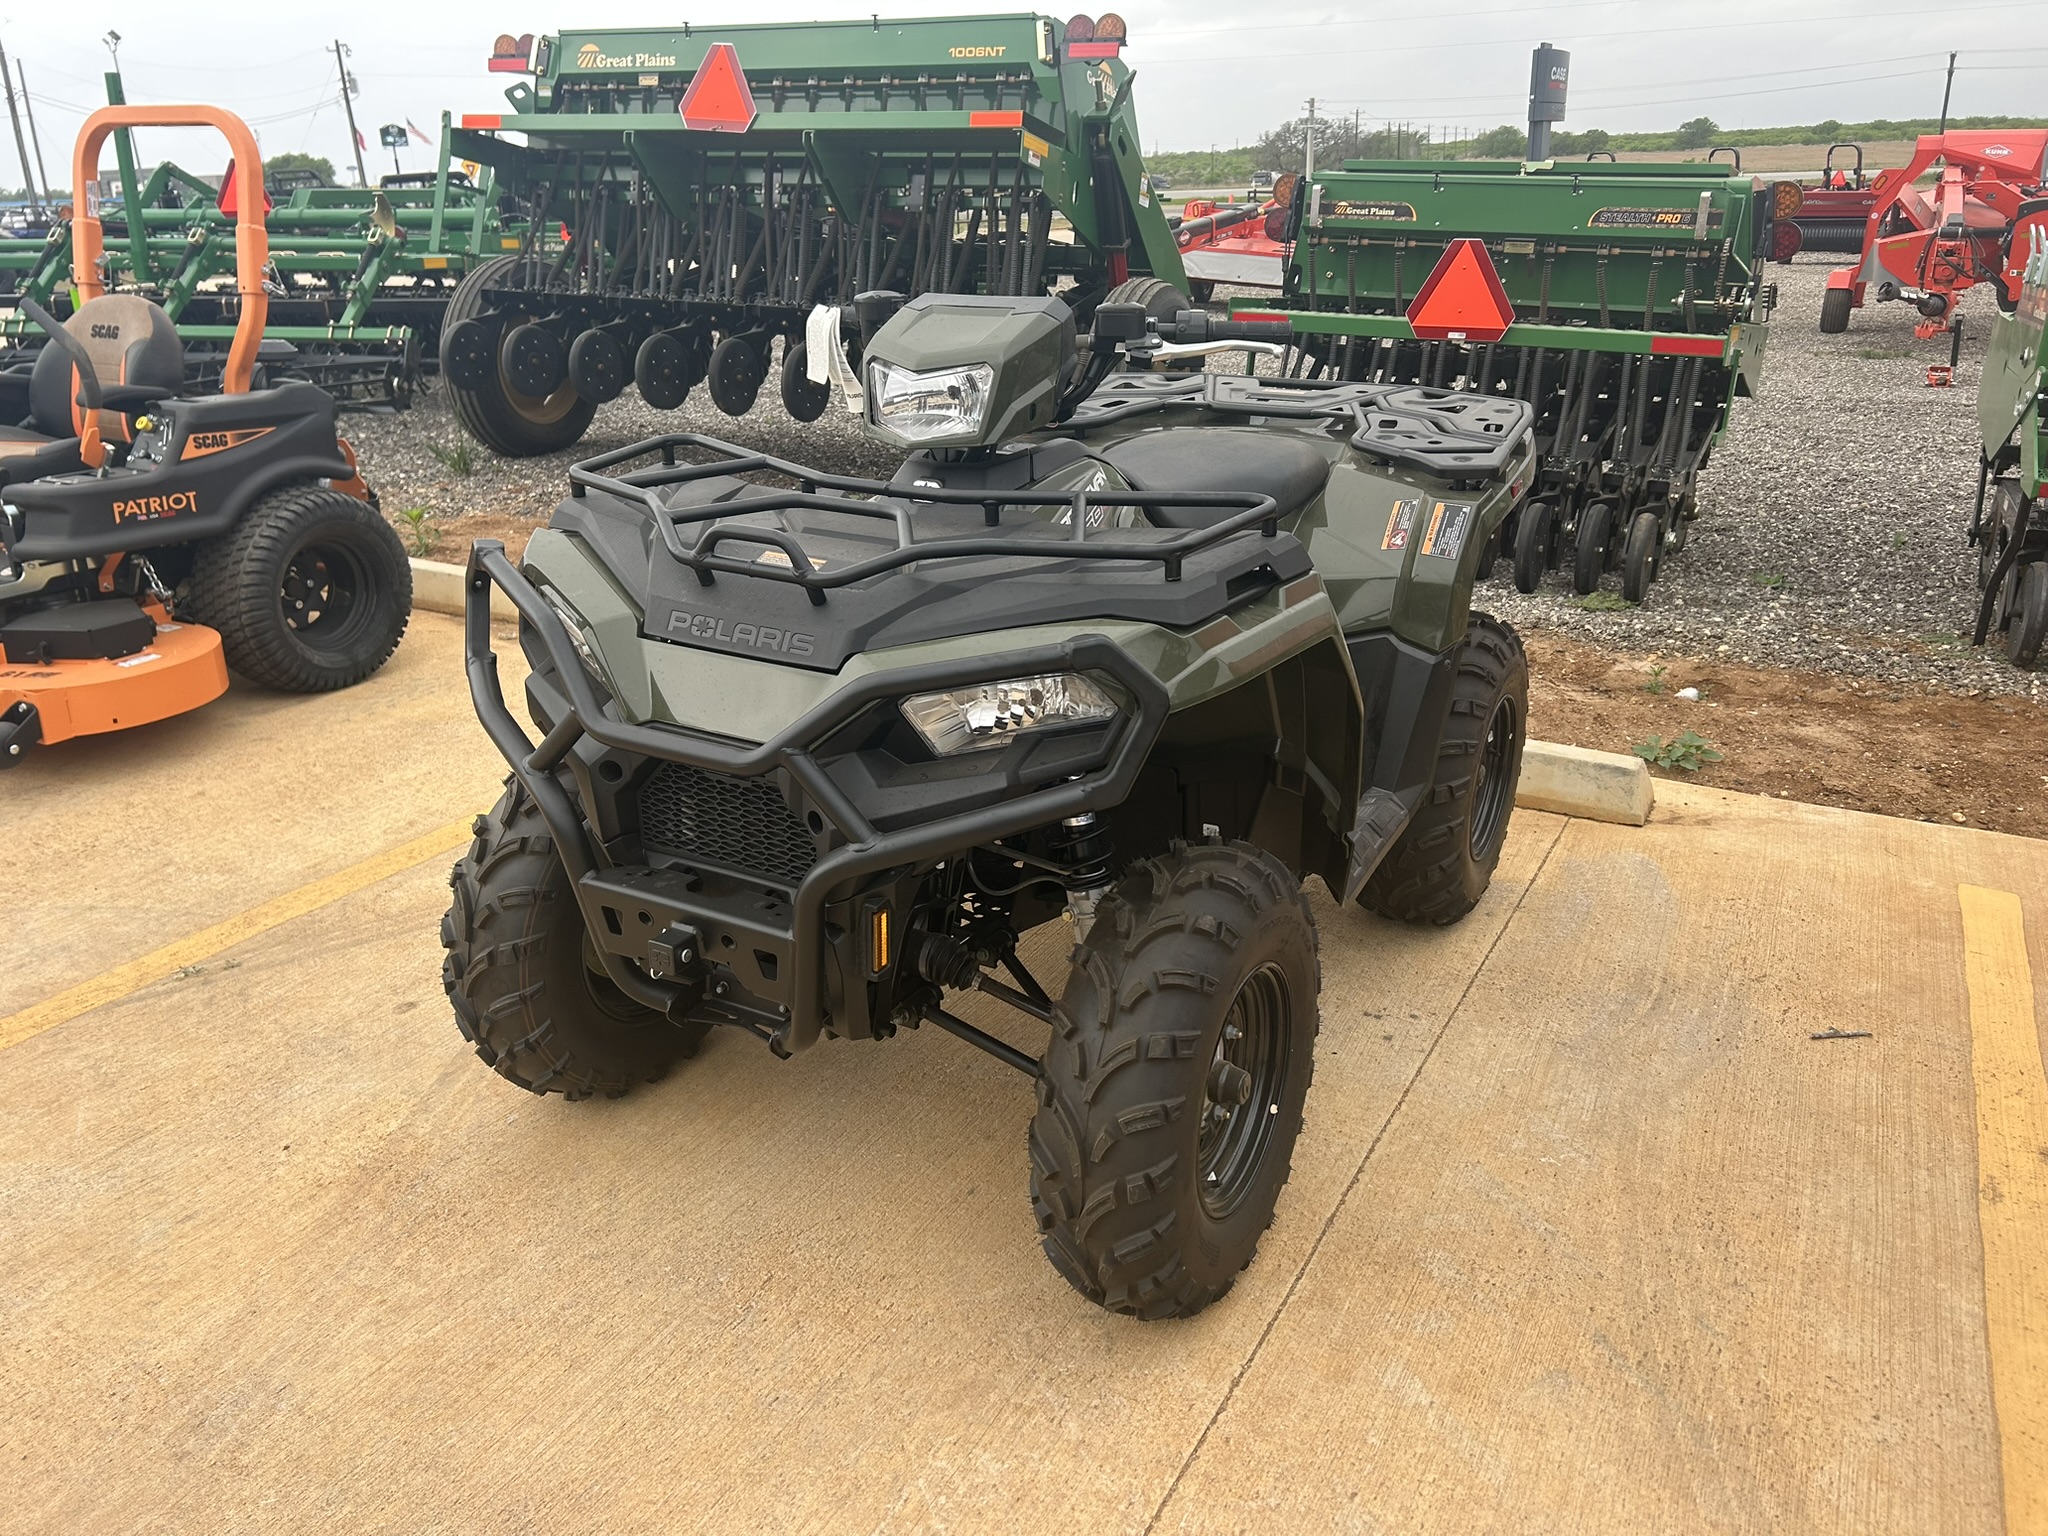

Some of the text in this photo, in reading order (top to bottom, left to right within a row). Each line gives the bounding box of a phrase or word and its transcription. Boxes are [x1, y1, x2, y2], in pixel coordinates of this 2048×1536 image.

[948, 46, 1006, 58] 1006NT
[596, 52, 676, 68] Great Plains
[1551, 66, 1567, 81] CASE
[1346, 207, 1396, 216] Great Plains
[1600, 212, 1652, 223] STEALTH
[1656, 213, 1682, 224] PRO
[91, 324, 120, 340] SCAG
[192, 434, 229, 449] SCAG
[113, 491, 197, 525] PATRIOT
[667, 609, 816, 657] POLARIS
